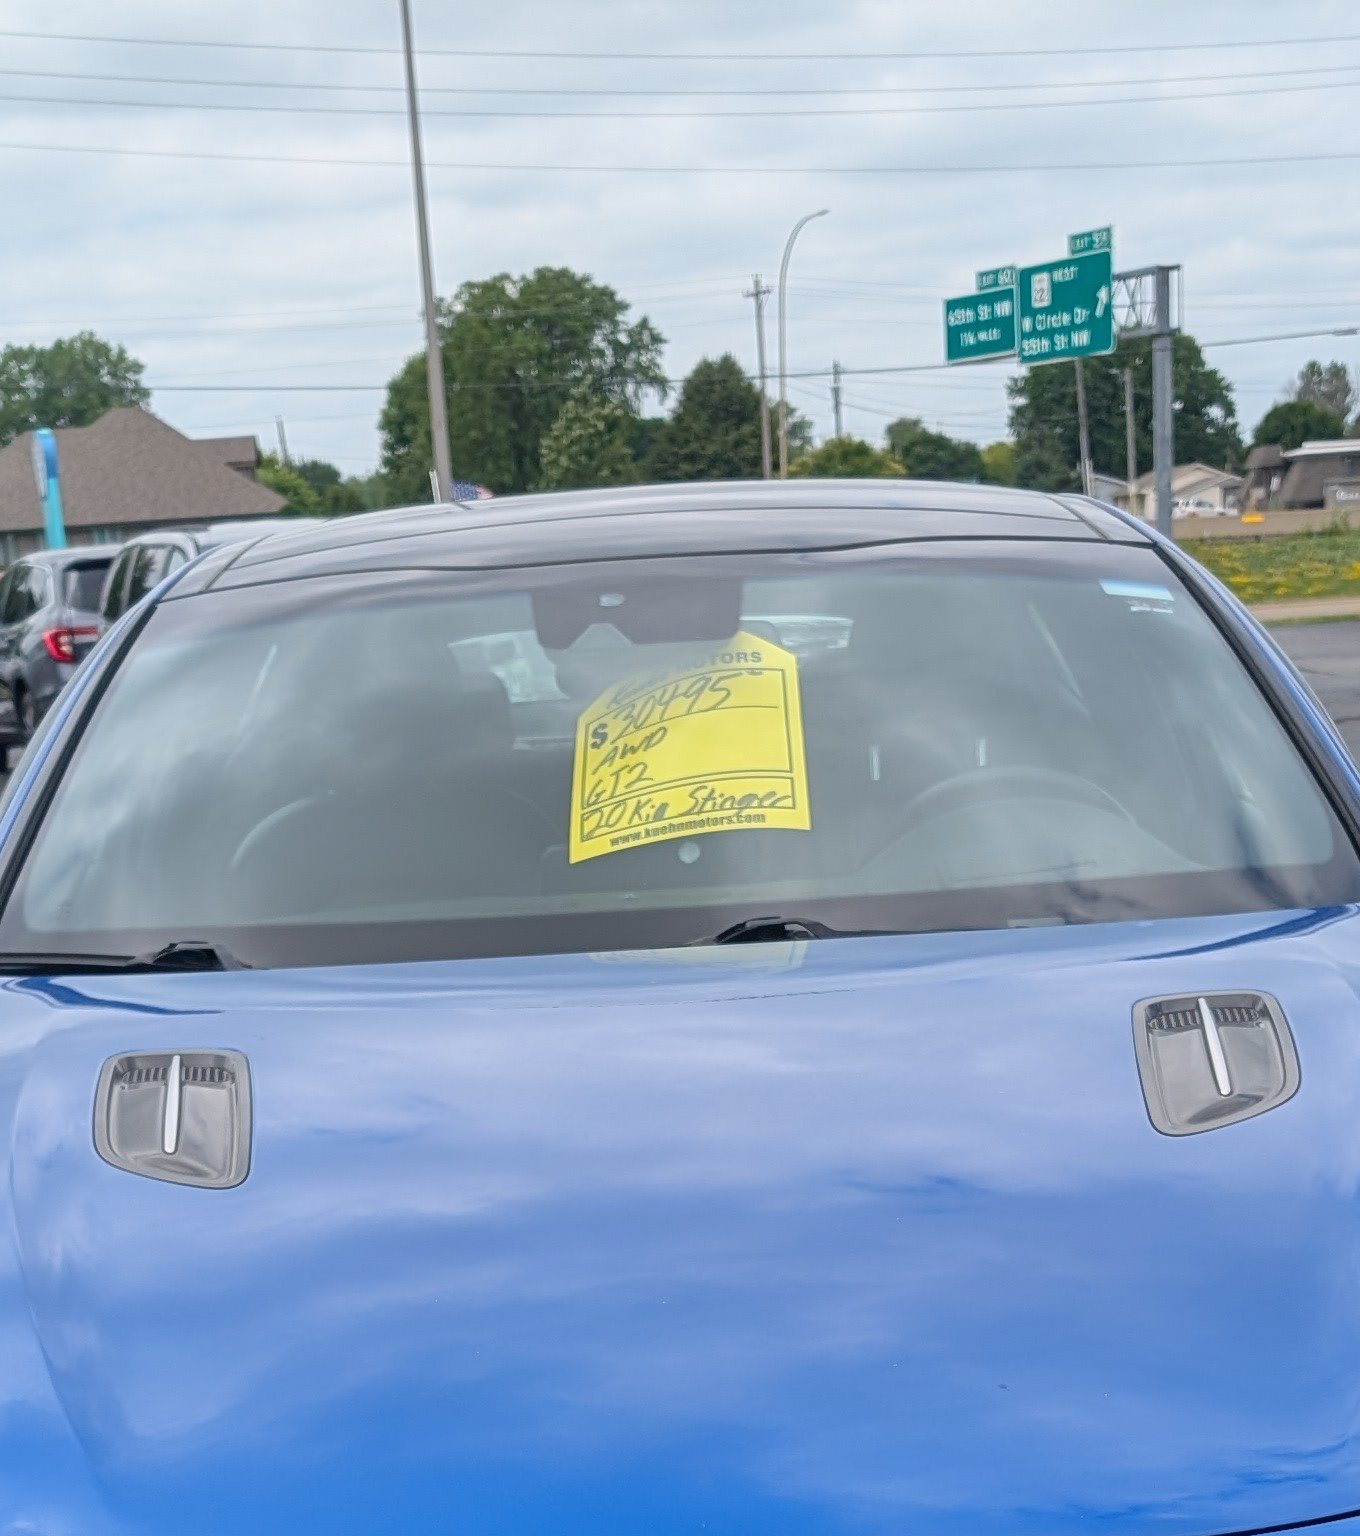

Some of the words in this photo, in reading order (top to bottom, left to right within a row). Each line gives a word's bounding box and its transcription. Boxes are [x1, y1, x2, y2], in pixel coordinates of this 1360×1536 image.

[977, 303, 992, 322] St
[994, 300, 1013, 318] NW
[1035, 311, 1071, 331] Circle
[1073, 307, 1091, 325] Dr
[1053, 332, 1069, 351] St
[1071, 329, 1092, 347] NW
[591, 726, 667, 775] AWD
[628, 798, 671, 825] Kia
[678, 786, 792, 817] Stinger
[610, 812, 766, 847] www.kuehnmotors.com
